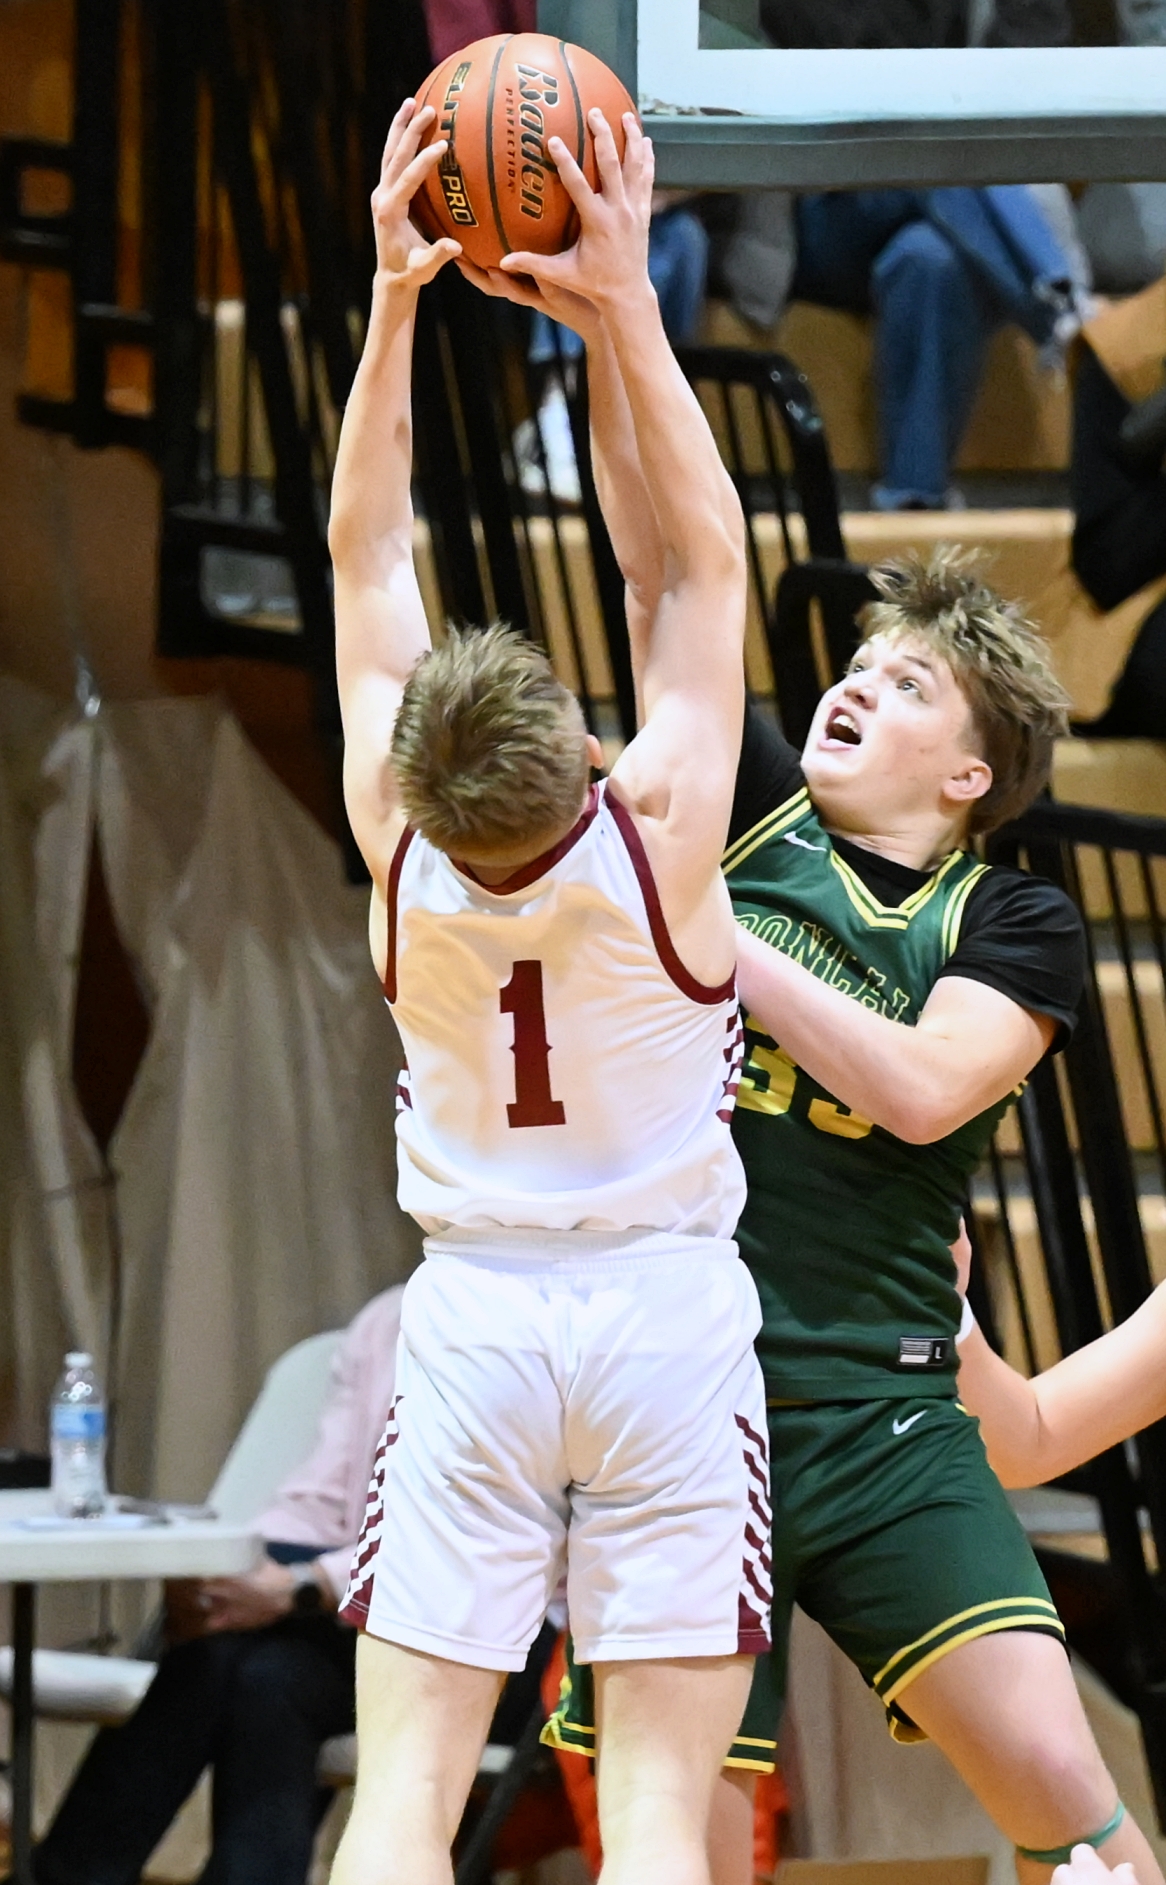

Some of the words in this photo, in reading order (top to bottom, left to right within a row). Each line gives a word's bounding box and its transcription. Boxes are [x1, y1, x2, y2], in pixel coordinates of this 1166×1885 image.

[442, 174, 473, 224] PRO
[516, 63, 559, 220] Baden
[499, 960, 566, 1128] 1
